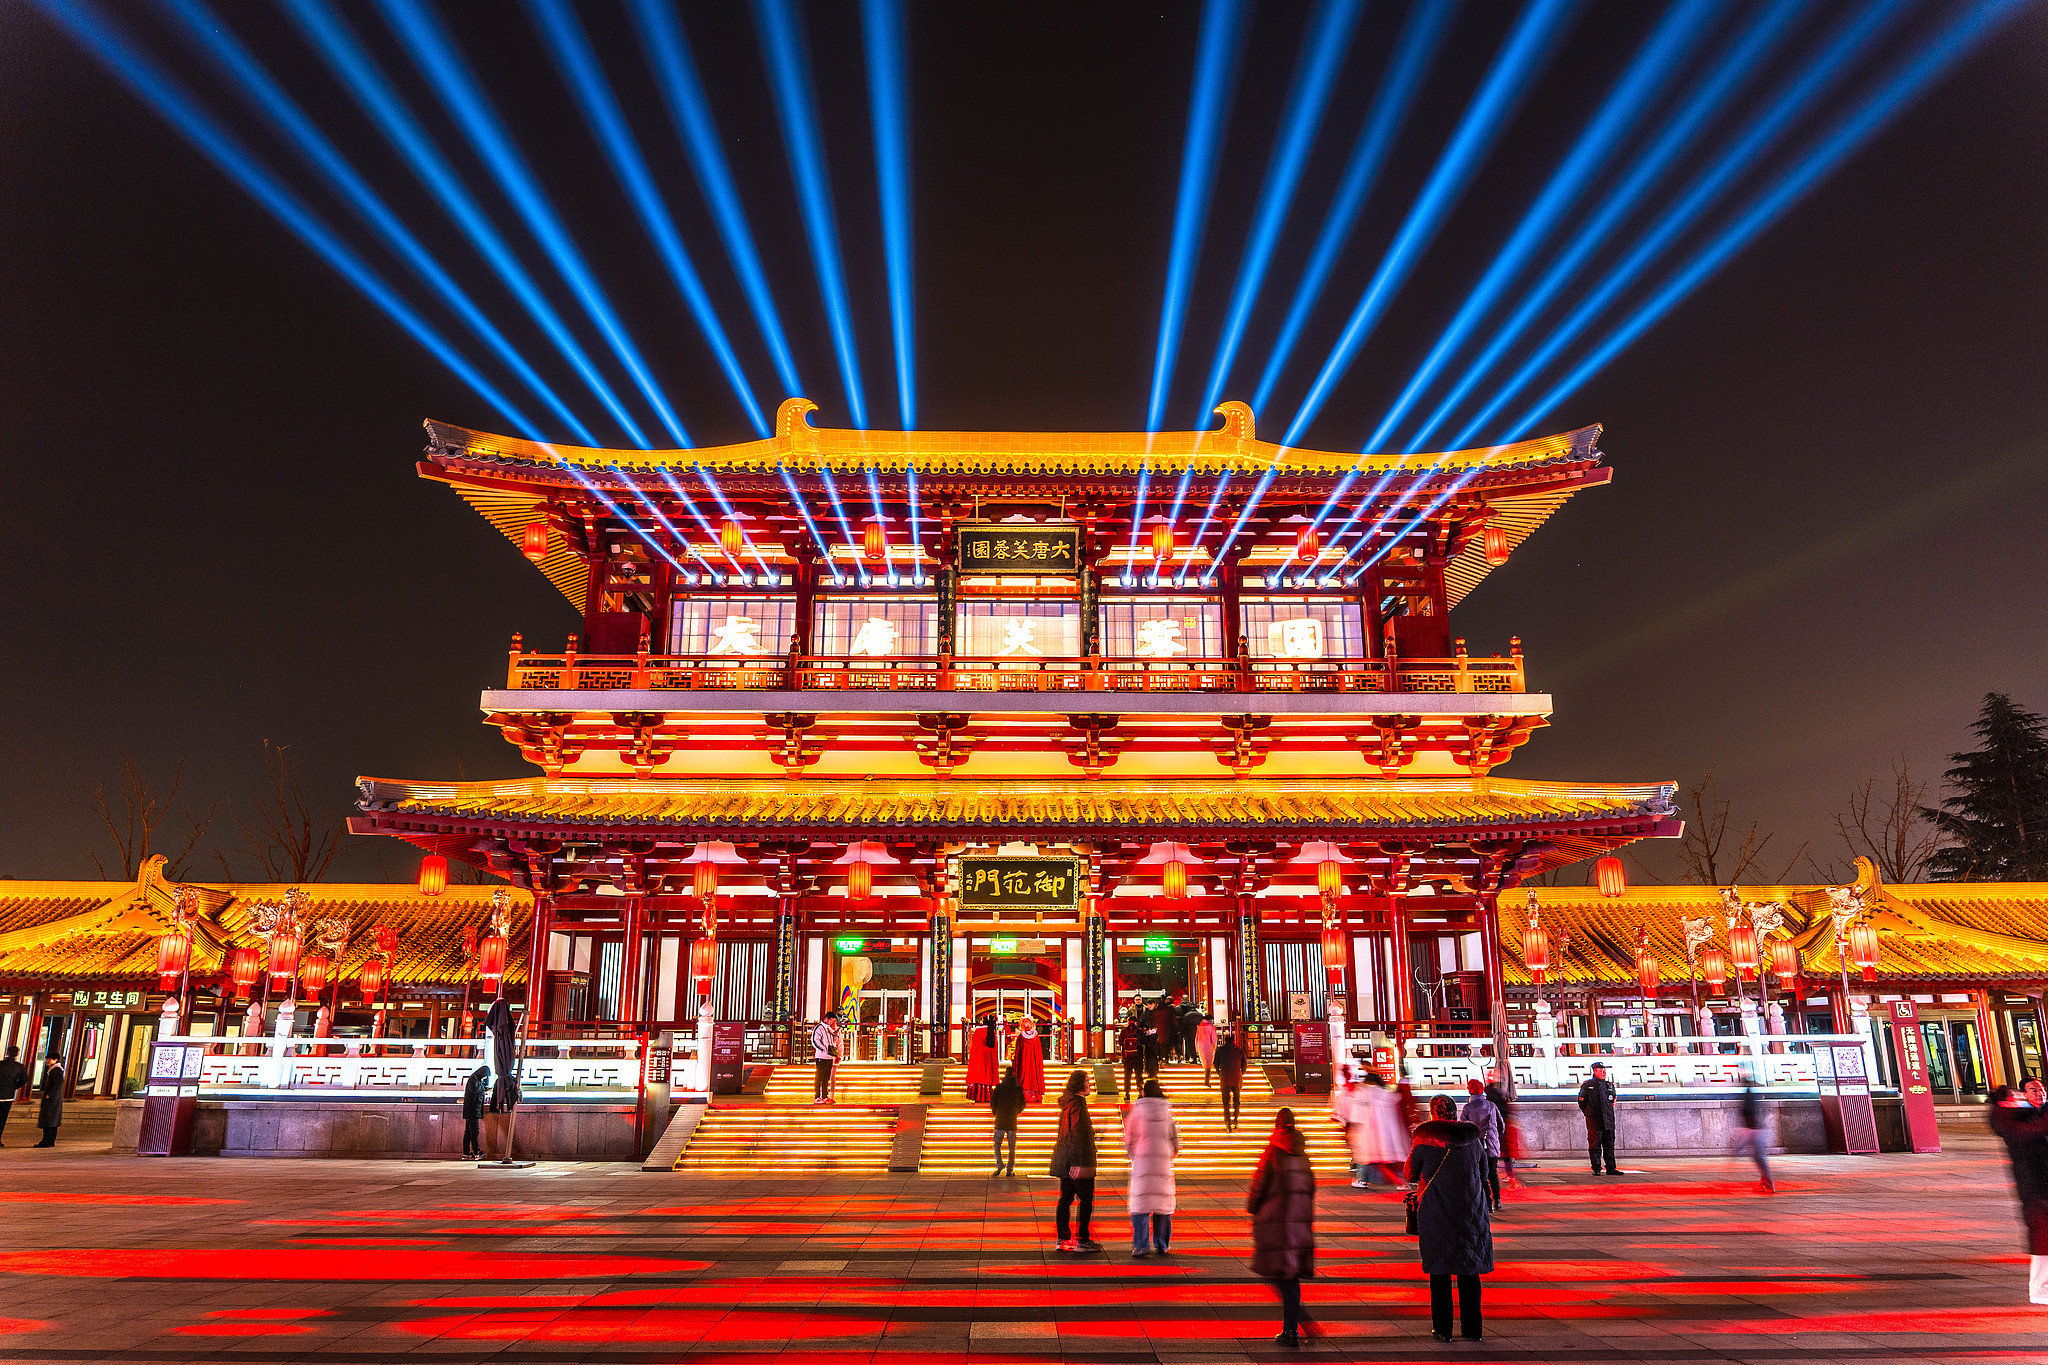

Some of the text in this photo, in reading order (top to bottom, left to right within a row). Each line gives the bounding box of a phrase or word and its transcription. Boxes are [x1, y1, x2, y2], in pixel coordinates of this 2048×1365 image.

[973, 540, 1071, 560] 大唐芙蓉園
[93, 991, 139, 1005] 卫生间
